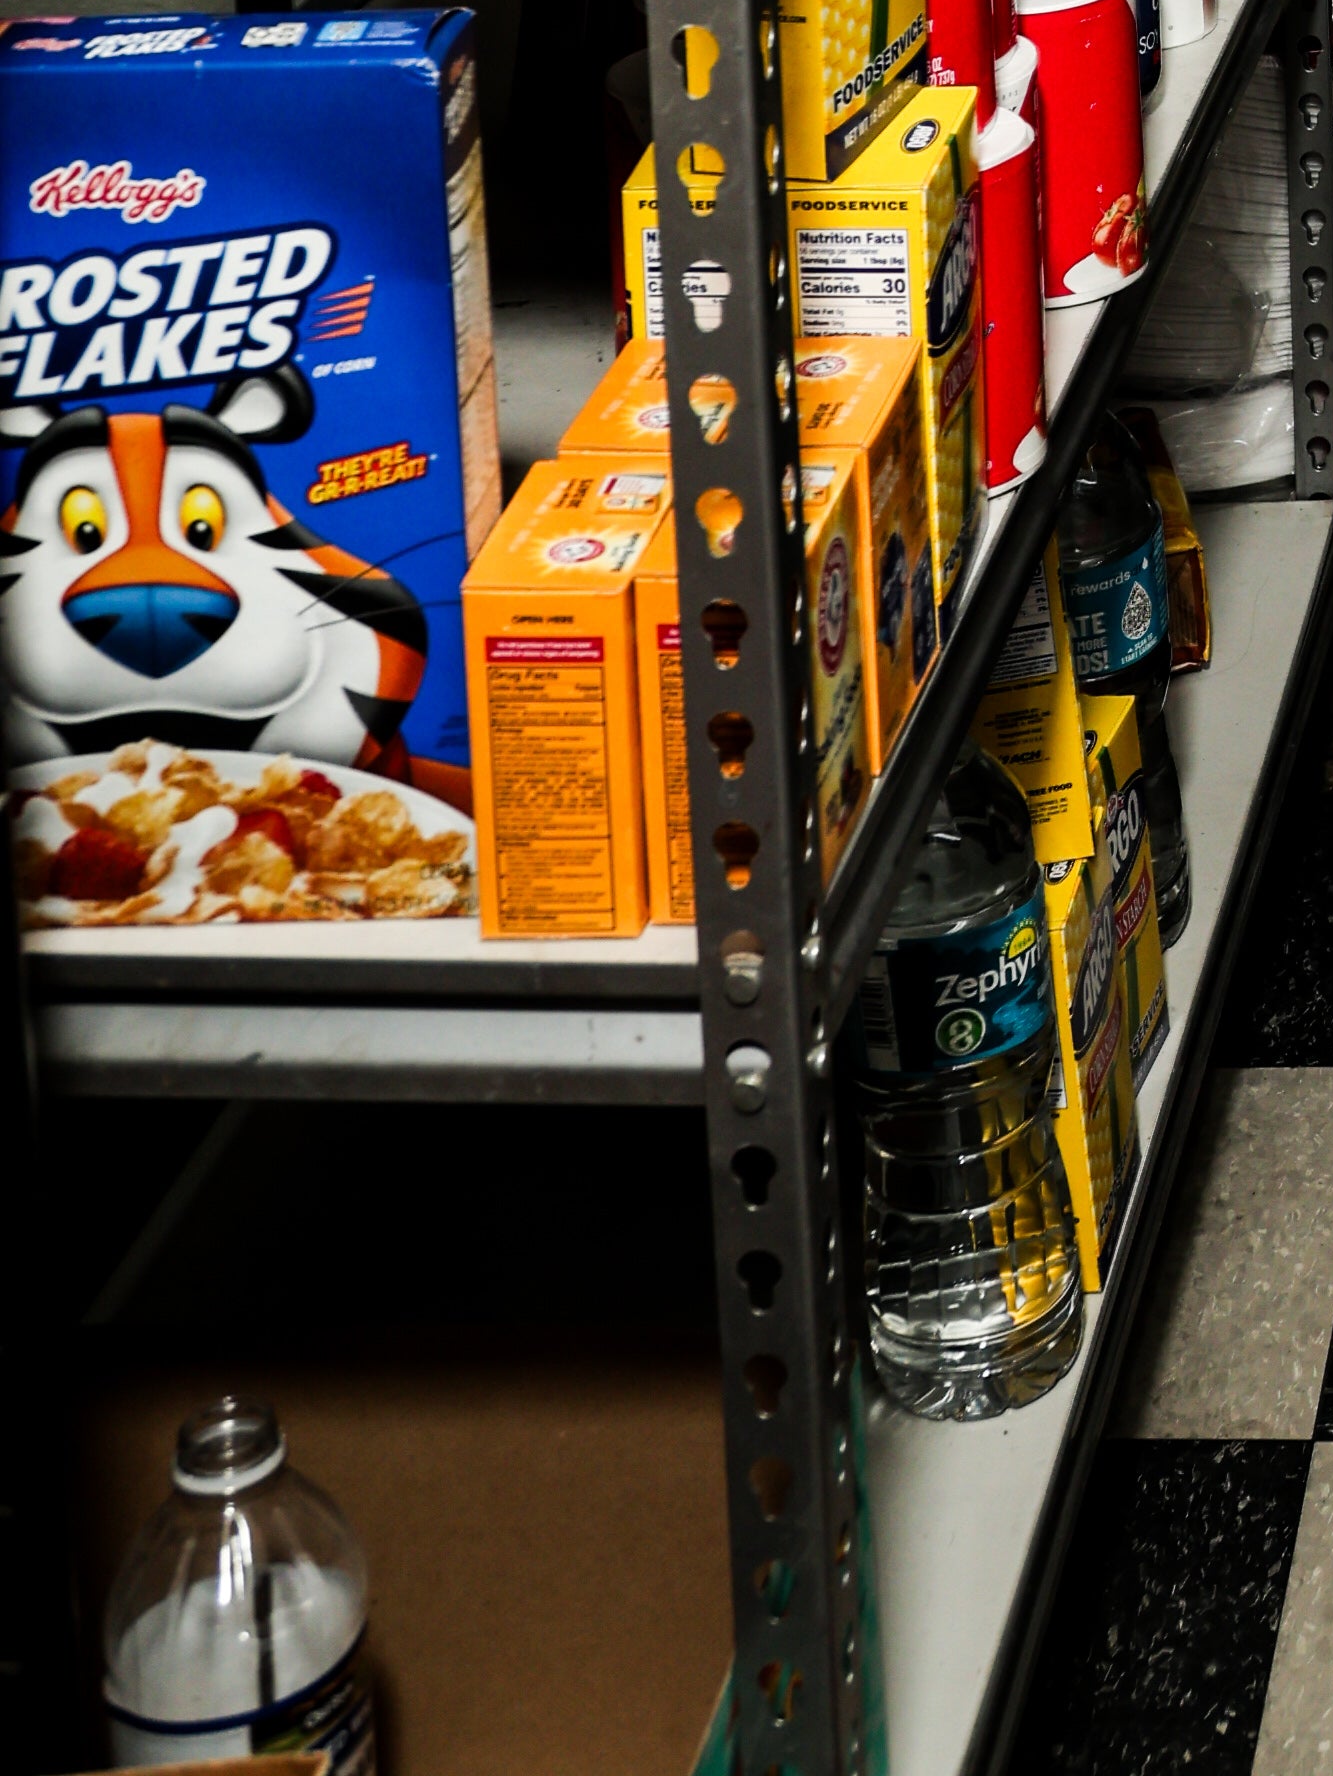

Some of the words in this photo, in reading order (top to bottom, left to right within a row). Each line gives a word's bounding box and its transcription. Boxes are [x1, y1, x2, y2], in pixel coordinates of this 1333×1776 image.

[833, 13, 924, 113] FOODSERVICE
[35, 164, 199, 220] Kellogg's
[791, 201, 908, 211] FOODSERVICE
[800, 232, 860, 244] Nutrition
[866, 233, 904, 244] Facts
[0, 229, 331, 331] ROSTED
[801, 282, 860, 294] Calories
[882, 279, 905, 293] 30
[319, 443, 410, 480] THEY'RE
[1070, 571, 1131, 596] rewards
[1078, 638, 1108, 652] MORE
